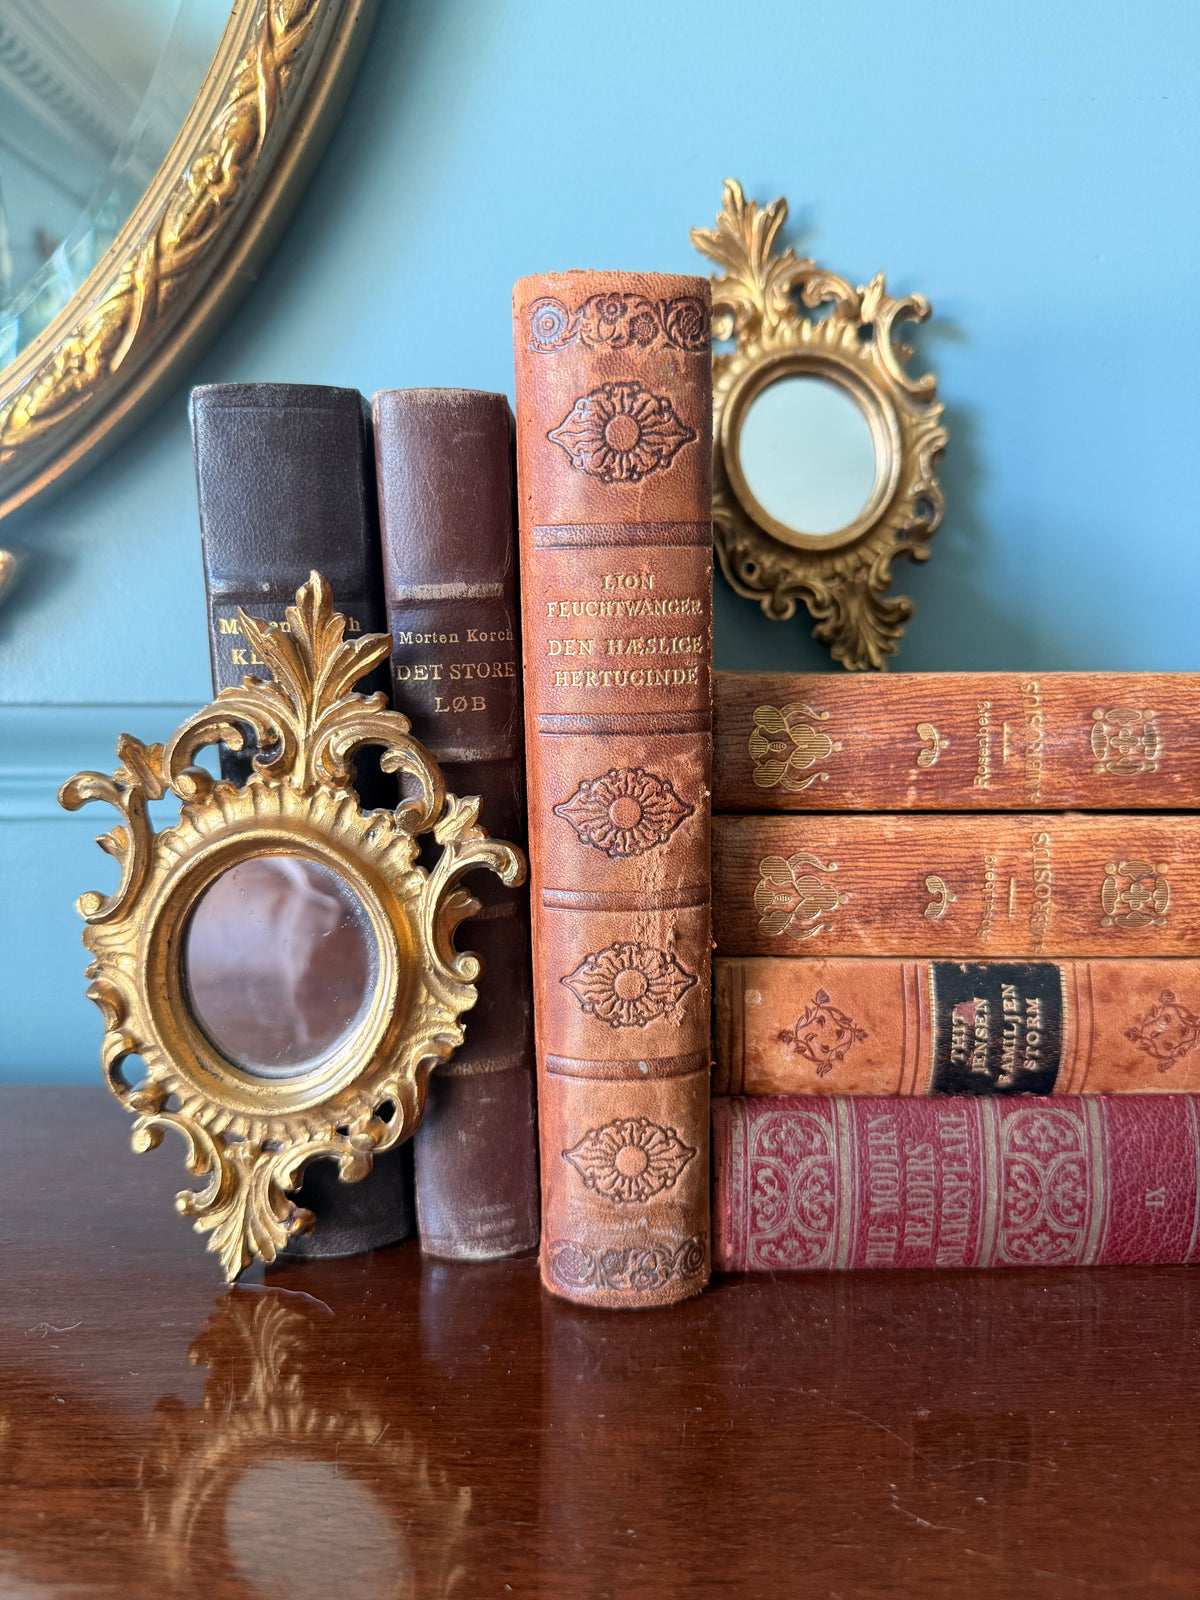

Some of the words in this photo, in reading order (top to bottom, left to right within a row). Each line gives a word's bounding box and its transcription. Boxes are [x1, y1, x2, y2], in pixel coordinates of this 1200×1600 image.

[602, 574, 655, 590] LION
[546, 598, 703, 618] FEUCHTWANGER
[399, 631, 460, 645] Morten
[466, 629, 514, 642] Korch
[547, 638, 595, 656] DEN
[606, 635, 704, 656] HÆSLIGE
[396, 664, 443, 681] DET
[449, 662, 515, 680] STORE
[554, 666, 699, 687] HERTUGINDE
[434, 696, 487, 713] LØB
[974, 699, 991, 789] Rosenberg
[1021, 681, 1043, 804] AMBROSIUS
[977, 850, 997, 941] Rosenberg
[950, 1008, 966, 1064] THIT
[971, 997, 990, 1076] JENSEN
[1023, 998, 1040, 1071] STORM
[867, 1113, 898, 1215] MODERN
[936, 1109, 971, 1266] SHAKESPEARE
[904, 1138, 935, 1247] READERS'
[1145, 1186, 1165, 1207] IX
[865, 1225, 897, 1264] THE
